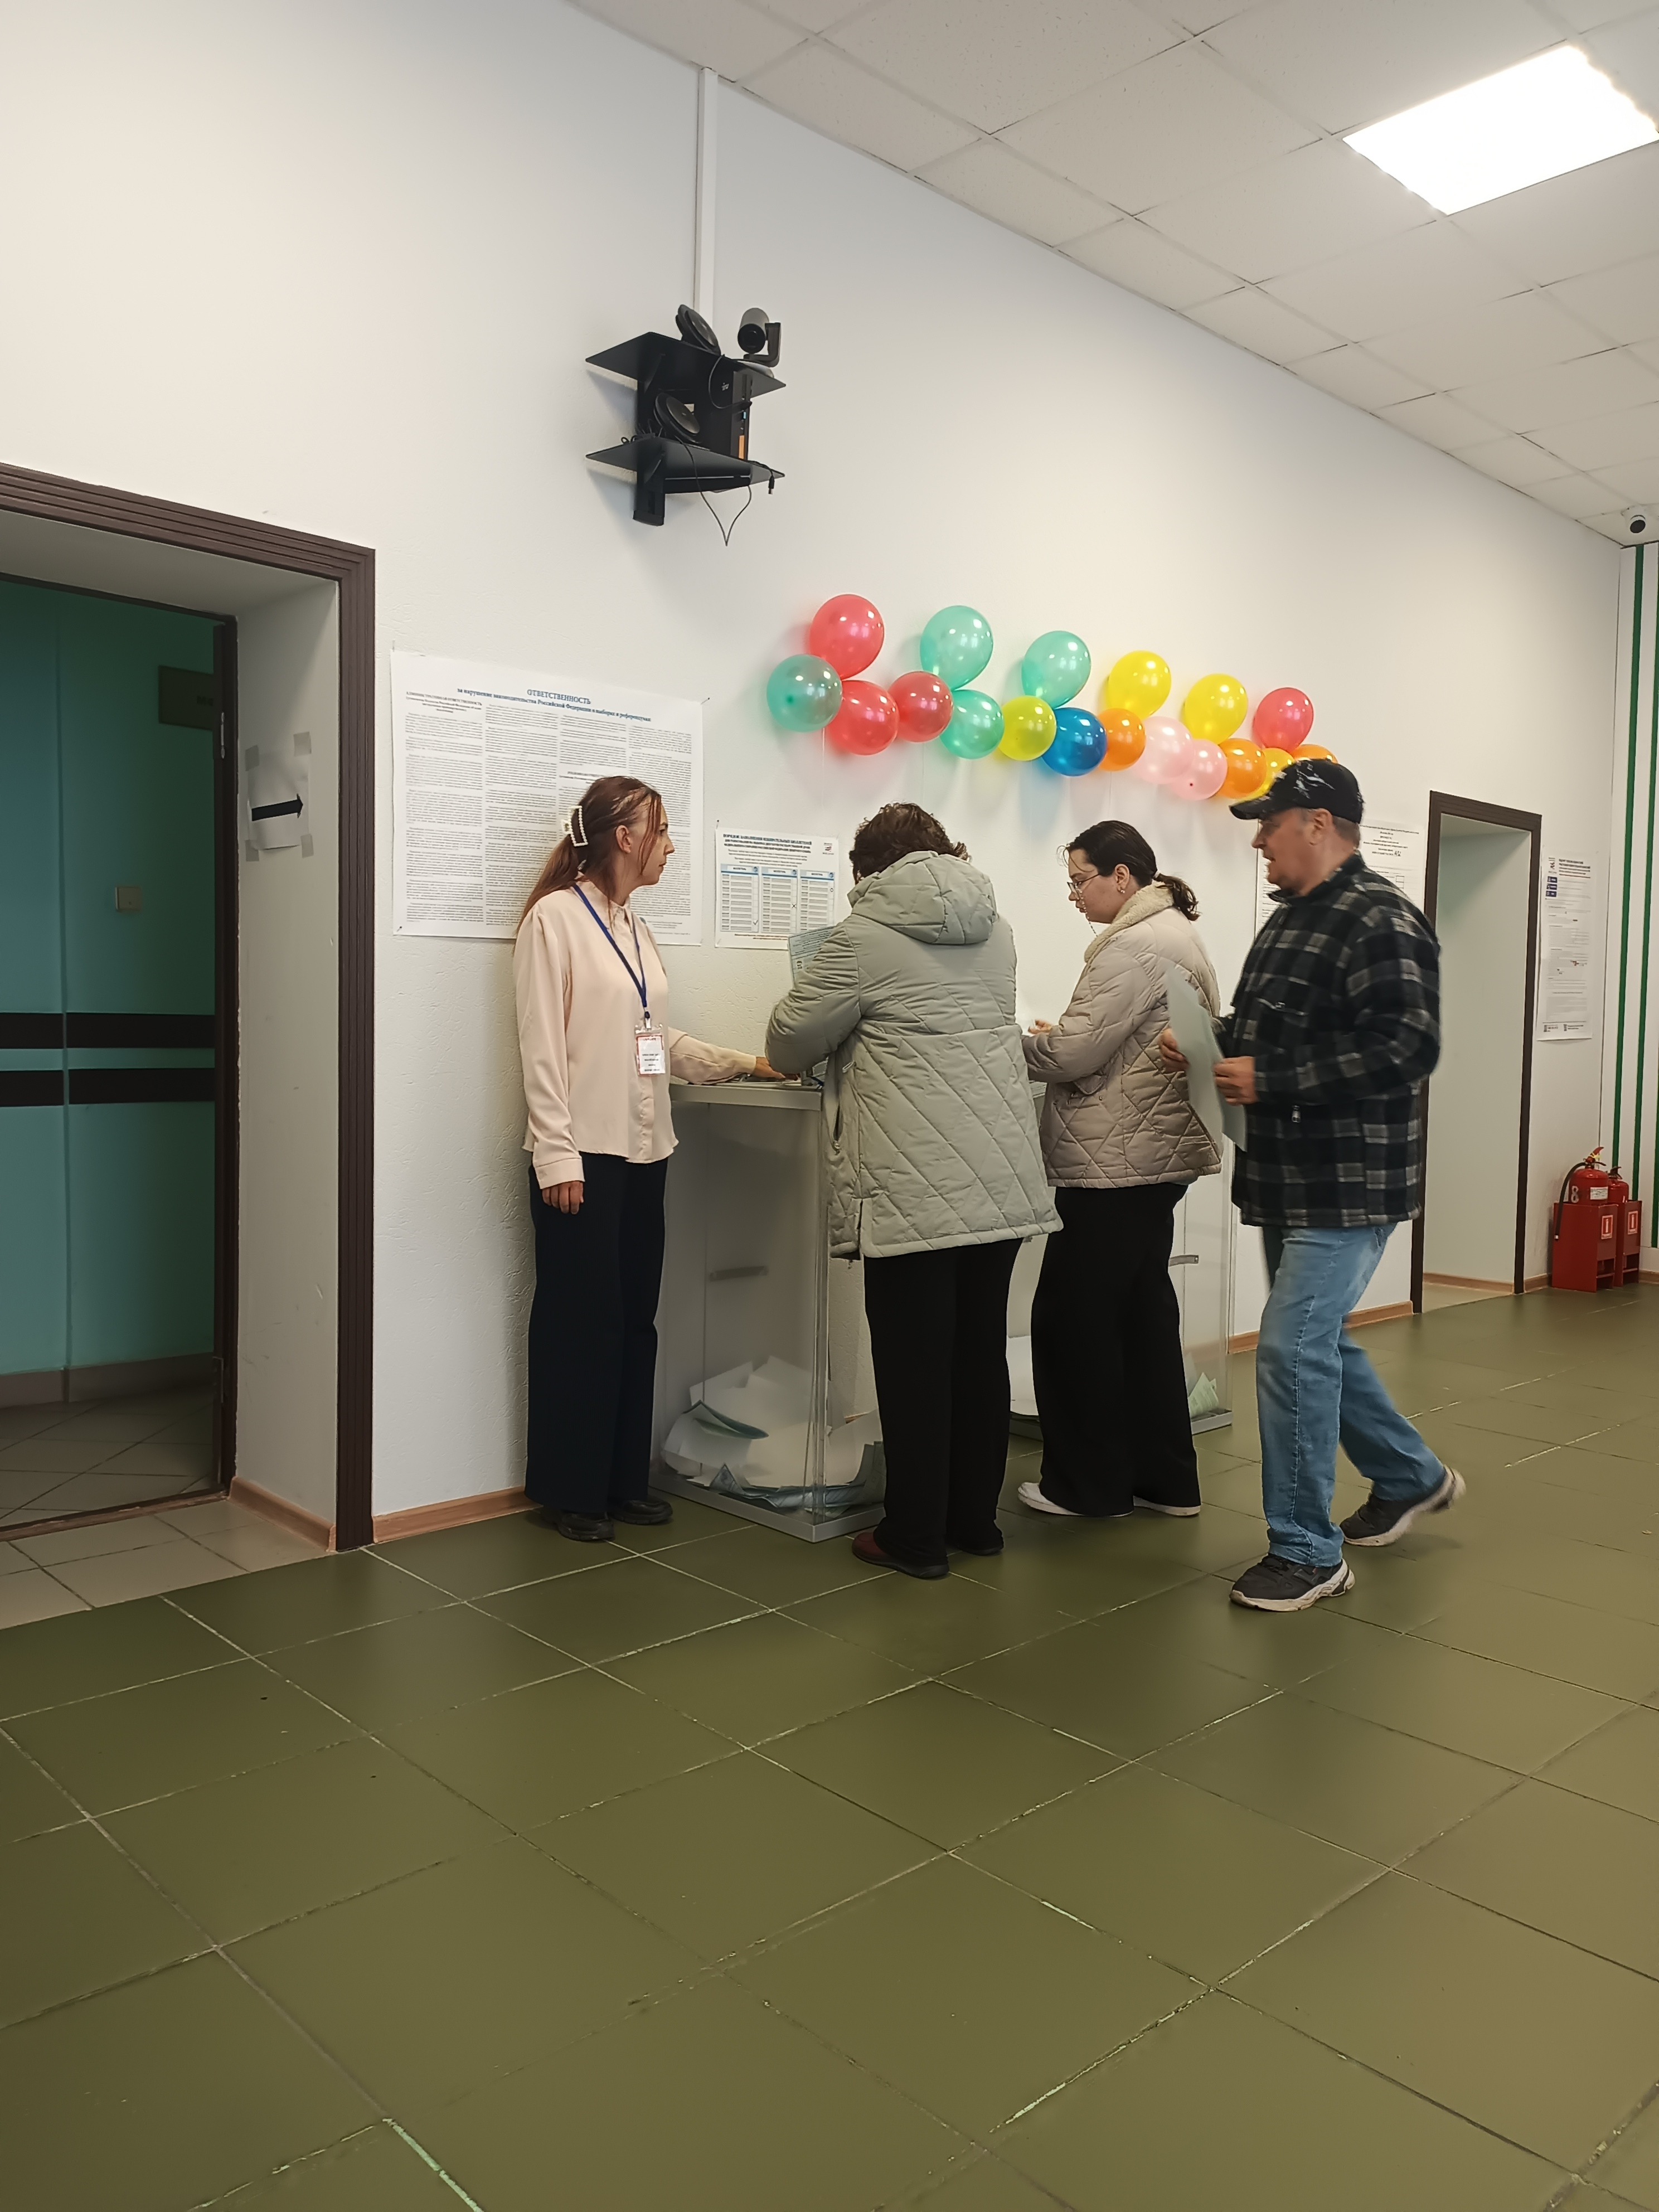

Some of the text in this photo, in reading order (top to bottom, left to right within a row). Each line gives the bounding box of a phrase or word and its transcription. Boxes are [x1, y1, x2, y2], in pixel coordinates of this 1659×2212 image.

[527, 689, 591, 704] ОТВЕТСТВЕННОСТЬ
[493, 694, 536, 704] законодательства
[537, 699, 565, 708] Российской
[565, 704, 591, 712] Федерации
[619, 713, 651, 722] референдумах
[1571, 1186, 1579, 1203] 8
